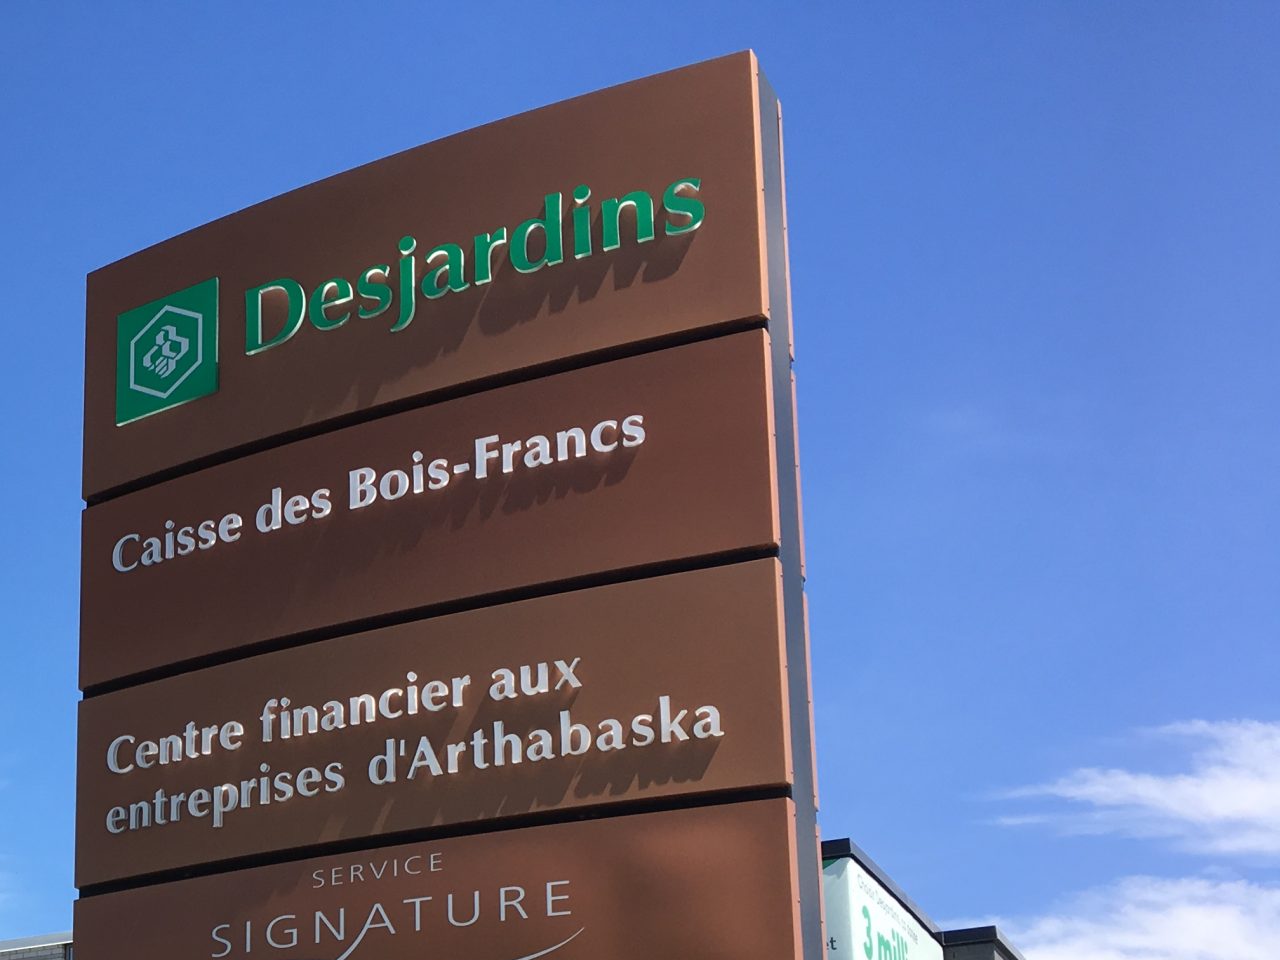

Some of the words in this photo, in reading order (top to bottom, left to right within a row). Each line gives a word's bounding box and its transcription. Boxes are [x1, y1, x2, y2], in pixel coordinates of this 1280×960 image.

[244, 177, 706, 355] Desjardins
[111, 508, 243, 573] Caisse
[255, 486, 332, 533] des
[348, 412, 647, 510] Bois-Francs
[106, 718, 244, 774] Centre
[260, 671, 472, 745] financier
[489, 656, 583, 700] aux
[106, 757, 346, 834] entreprises
[368, 695, 725, 785] d'Arthabaska
[210, 880, 573, 960] SIGNATURE
[311, 853, 444, 888] SERVICE
[862, 905, 874, 960] 3
